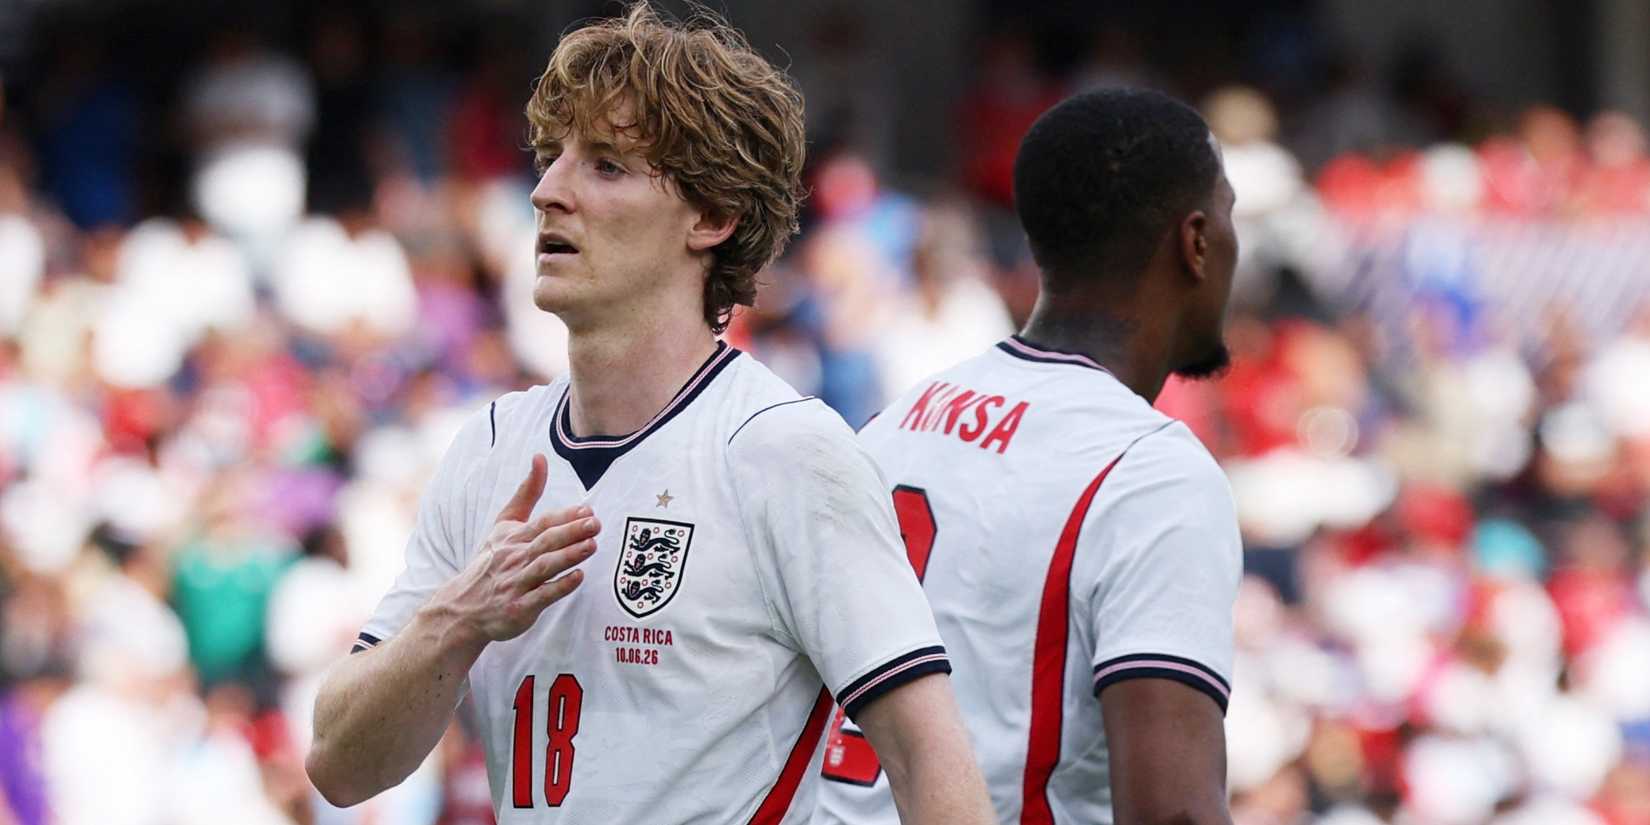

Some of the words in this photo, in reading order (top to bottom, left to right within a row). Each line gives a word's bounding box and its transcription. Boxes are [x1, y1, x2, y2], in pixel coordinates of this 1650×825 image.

[604, 626, 640, 644] COSTA
[643, 628, 673, 646] RICA
[616, 647, 658, 665] 10.06.26
[512, 673, 584, 809] 18
